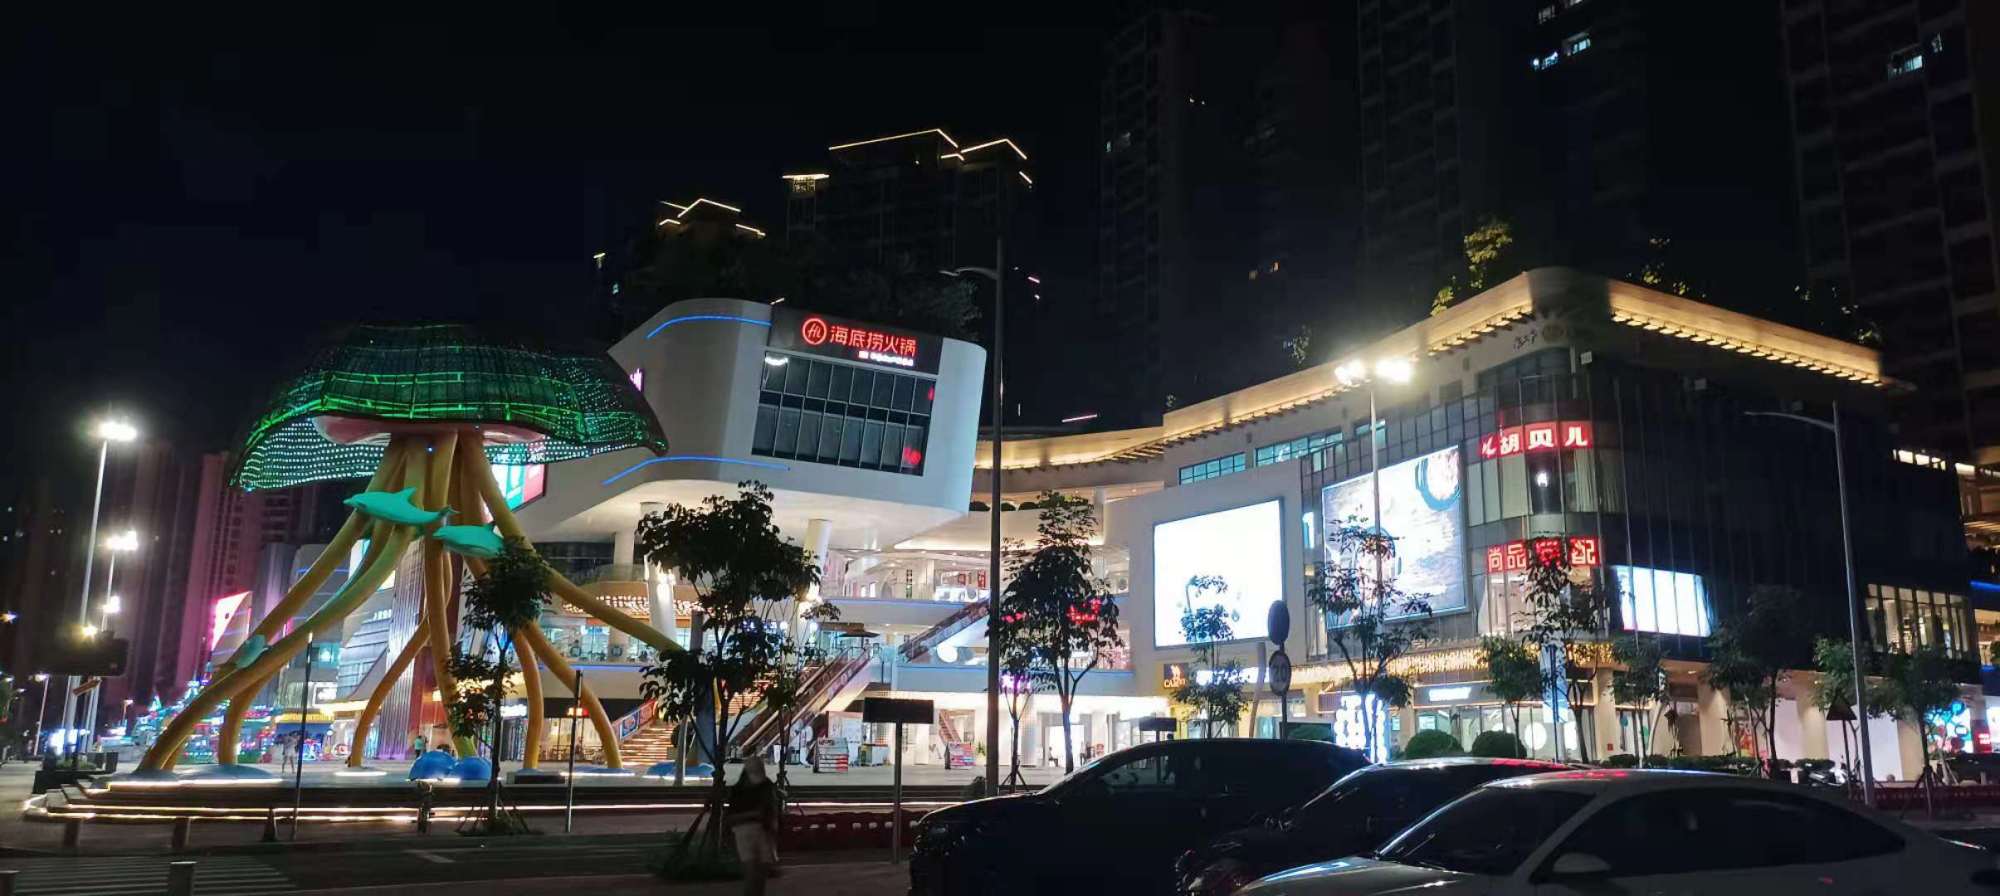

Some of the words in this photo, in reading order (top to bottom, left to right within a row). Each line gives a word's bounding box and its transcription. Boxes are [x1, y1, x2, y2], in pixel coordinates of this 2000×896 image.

[829, 326, 916, 356] 海底捞火锅
[1500, 427, 1588, 455] 胡贝儿
